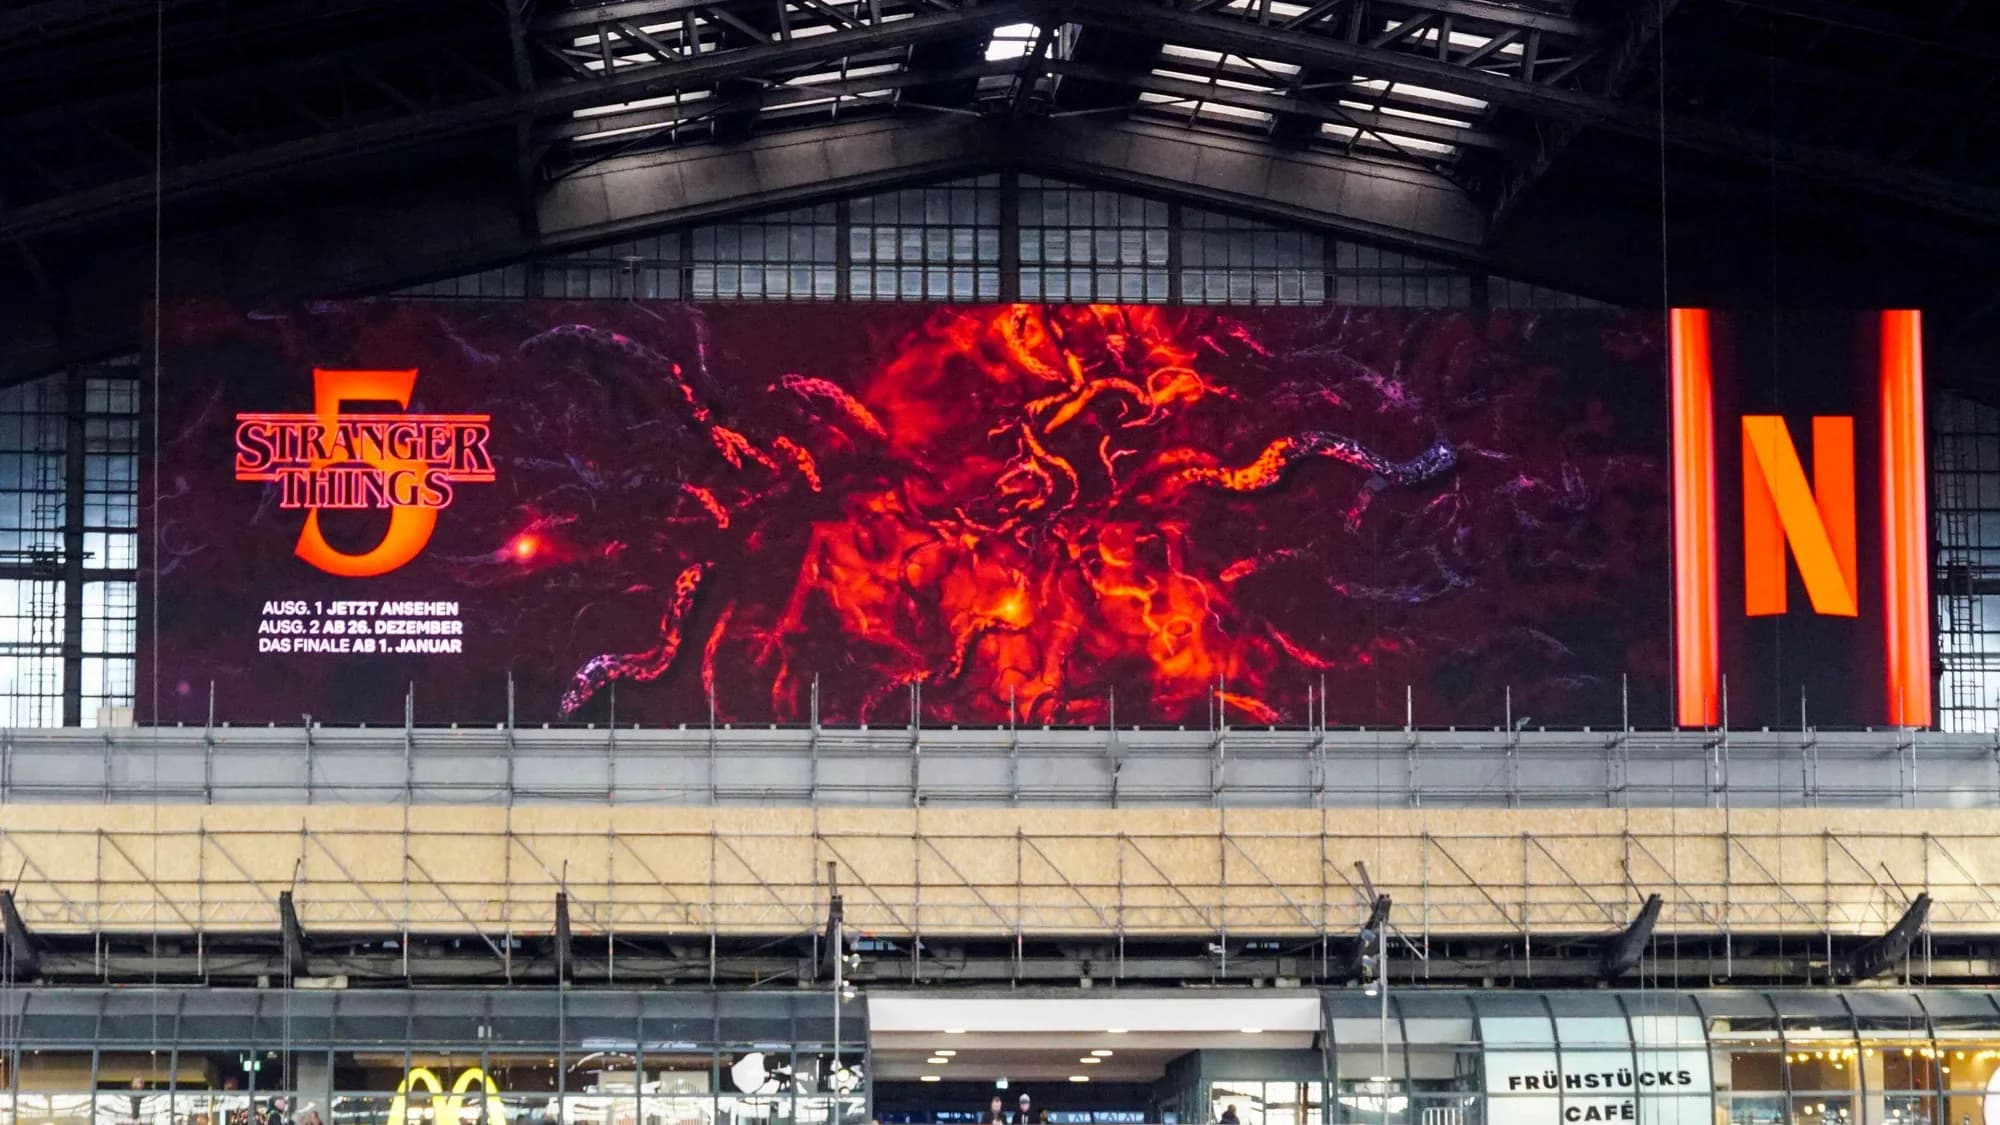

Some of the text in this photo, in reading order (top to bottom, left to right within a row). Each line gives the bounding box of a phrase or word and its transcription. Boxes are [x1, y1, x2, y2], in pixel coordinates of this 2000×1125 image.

[235, 421, 496, 473] STRANGER
[294, 367, 439, 577] 5
[274, 467, 454, 509] THINGS
[1741, 415, 1858, 617] N
[262, 601, 459, 616] AUSG. 1 JETZT ANSEHEN
[258, 620, 463, 635] AUSG. 2 AB 26. DEZEMBER
[259, 638, 463, 653] DAS FINALE AB 1. JANUAR
[1508, 1068, 1692, 1091] FRÜHSTÜCKS
[1565, 1100, 1635, 1122] CAFÉ
